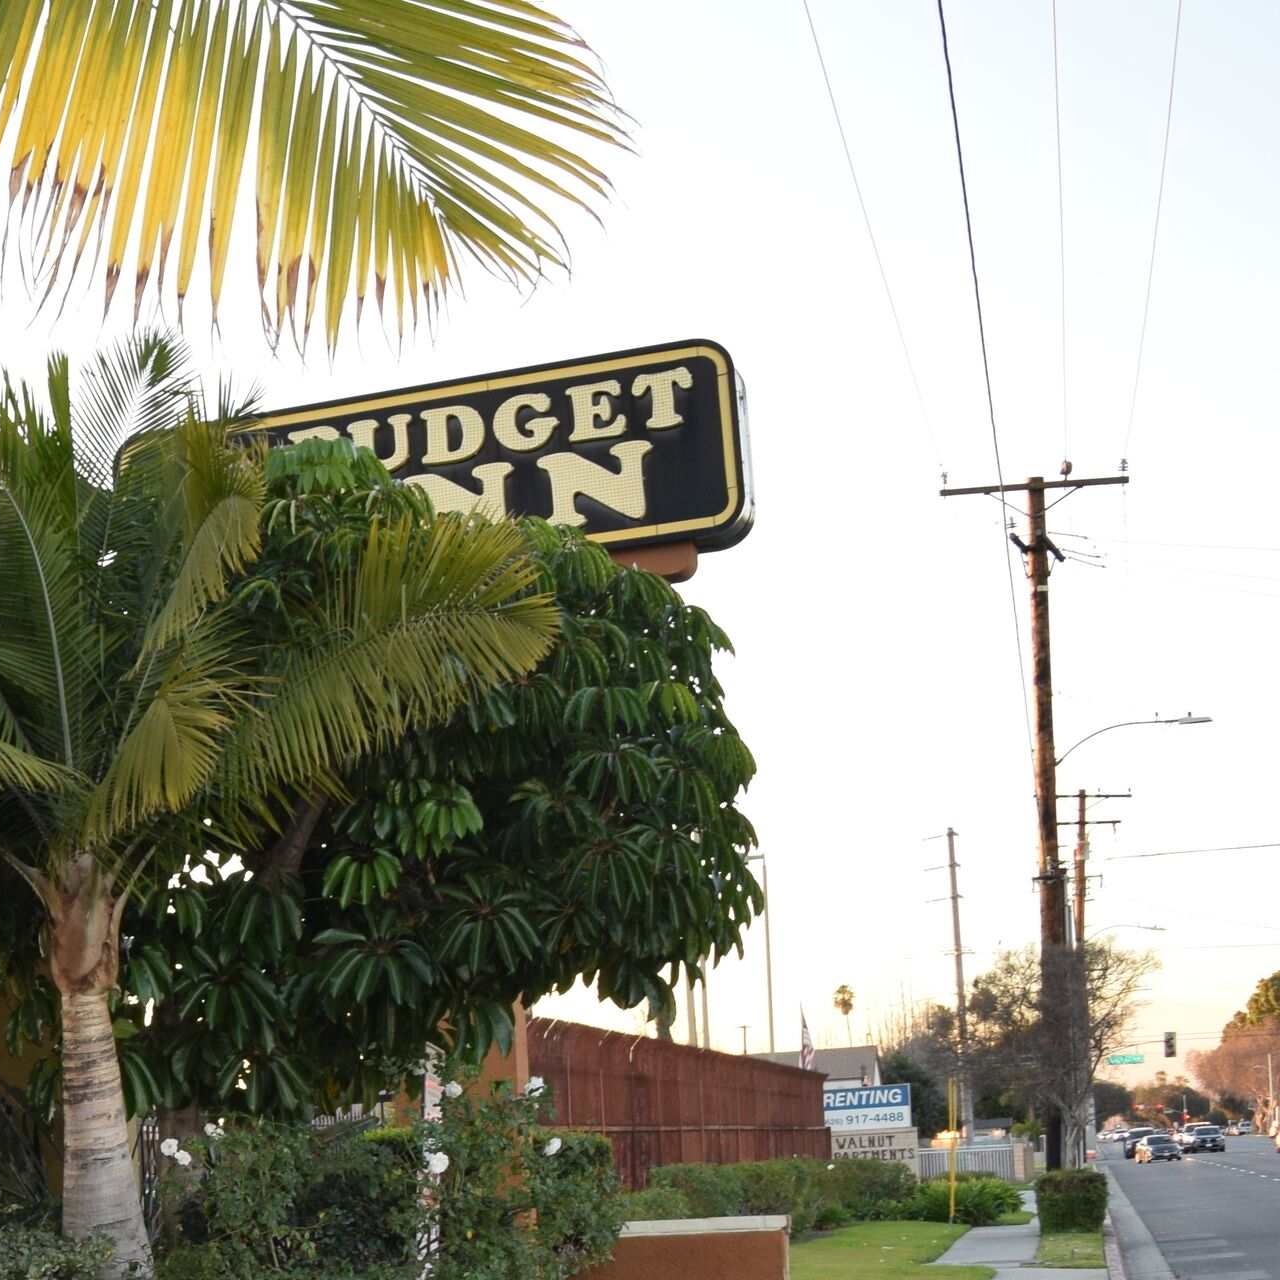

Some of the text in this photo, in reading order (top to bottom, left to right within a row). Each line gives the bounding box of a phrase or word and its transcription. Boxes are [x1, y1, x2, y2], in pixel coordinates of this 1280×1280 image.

[288, 367, 693, 473] UDGET
[402, 440, 653, 528] NN
[824, 1089, 902, 1108] RENTING
[846, 1112, 904, 1125] 917-4488
[834, 1148, 915, 1160] PARTMENTS
